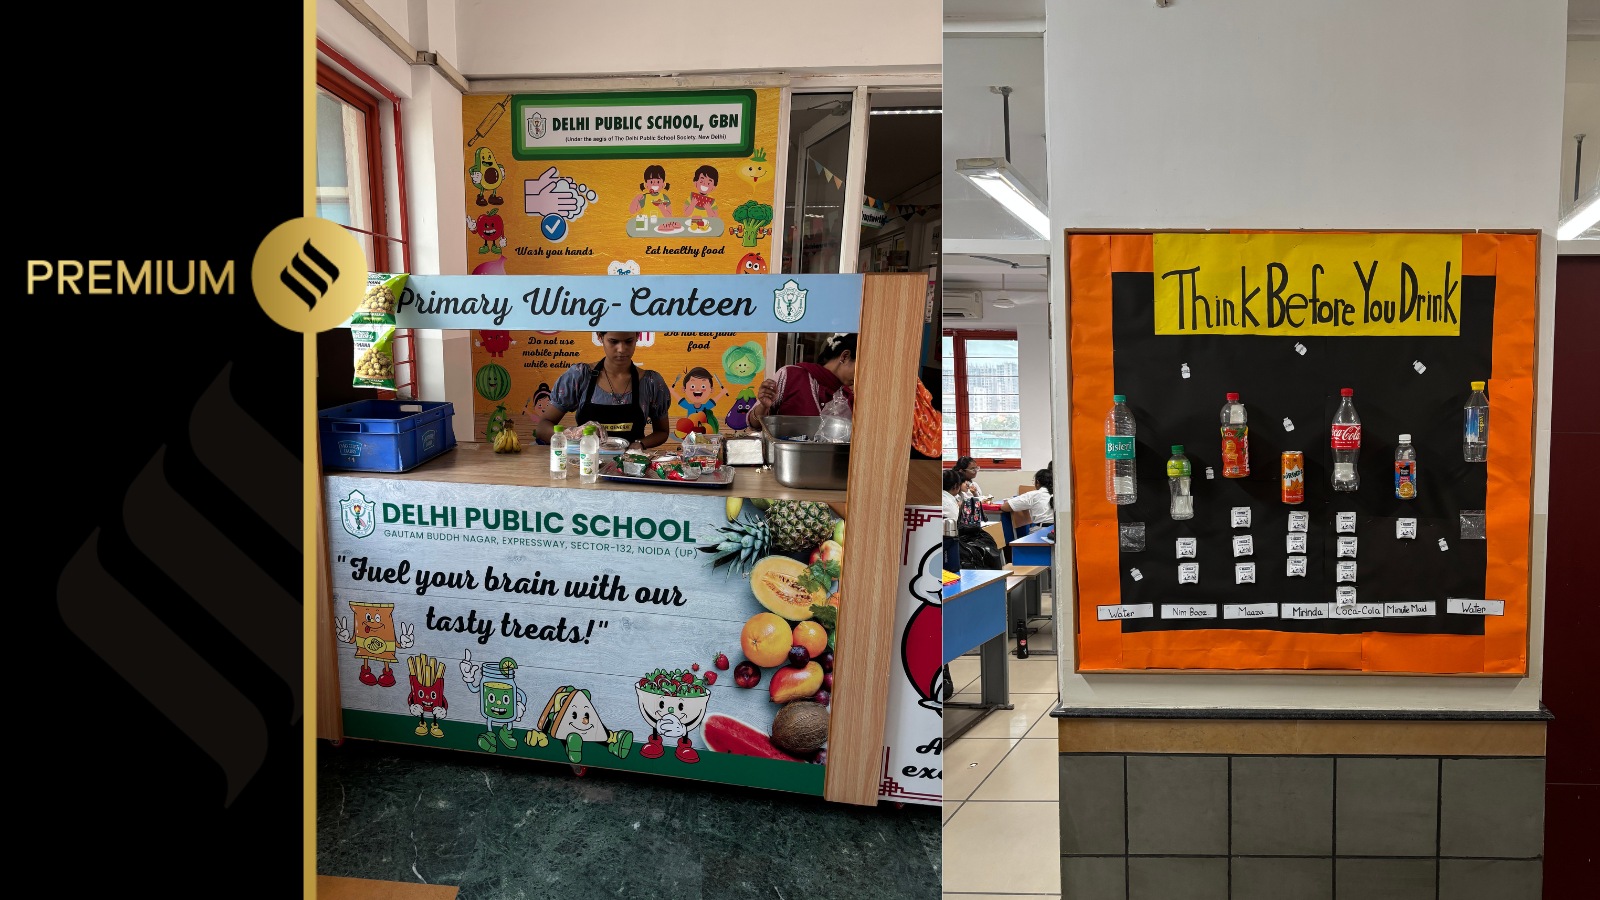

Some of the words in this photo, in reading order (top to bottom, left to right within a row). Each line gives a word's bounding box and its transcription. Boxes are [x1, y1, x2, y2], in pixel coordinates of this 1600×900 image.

[552, 116, 589, 131] DELHI
[595, 115, 642, 130] PUBLIC
[646, 114, 704, 131] SCHOOL,
[708, 113, 739, 128] GBN
[514, 246, 543, 256] Wash
[545, 248, 564, 258] you
[565, 246, 594, 256] hands
[645, 245, 661, 255] Eat
[662, 245, 699, 257] healthy
[699, 245, 725, 257] food
[1161, 265, 1261, 331] Think
[1266, 261, 1355, 328] Before
[1353, 260, 1396, 324] You
[1399, 261, 1458, 325] Drink
[396, 286, 513, 326] Primary
[630, 287, 757, 317] Canteen
[527, 336, 542, 345] Do
[543, 337, 558, 345] not
[687, 340, 710, 352] food
[522, 348, 552, 357] mobile
[553, 348, 580, 359] phone
[524, 360, 548, 368] while
[550, 360, 574, 369] eatin
[1107, 441, 1132, 452] Bisleri
[382, 502, 457, 528] DELHI
[465, 507, 564, 534] PUBLIC
[571, 513, 696, 543] SCHOOL
[384, 529, 424, 540] GAUTAM
[426, 532, 460, 542] BUDDH
[463, 533, 499, 546] NAGAR,
[502, 536, 568, 551] EXPRESSWAY,
[570, 541, 634, 555] SECTOR-132,
[637, 546, 671, 556] NOIDA
[675, 547, 698, 560] (UP)
[415, 569, 479, 596] your
[484, 565, 559, 597] brain
[564, 574, 629, 602] with
[634, 585, 687, 607] our
[1107, 608, 1135, 618] Water
[1172, 607, 1187, 616] Nim
[1238, 606, 1264, 616] Maaza
[1335, 605, 1381, 616] Coca-Cola
[1461, 601, 1486, 614] Water
[426, 606, 496, 645] tasty
[501, 612, 609, 645] treats!"
